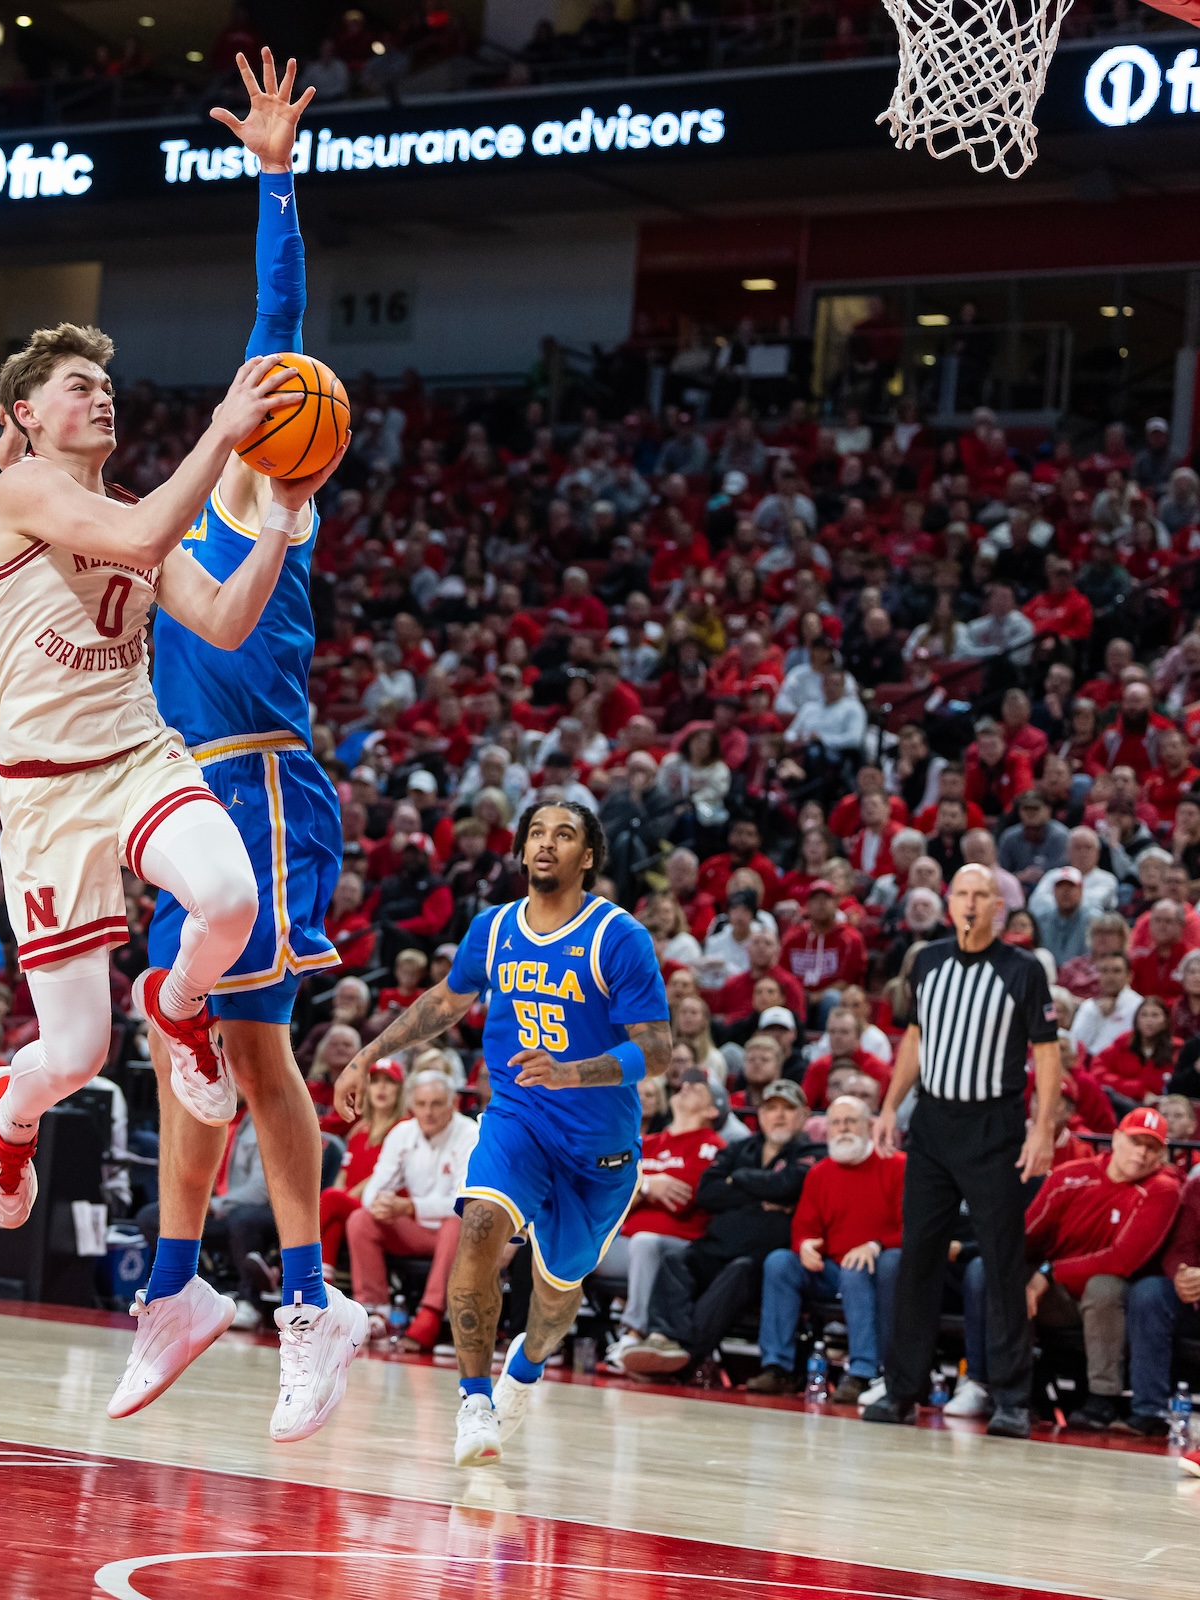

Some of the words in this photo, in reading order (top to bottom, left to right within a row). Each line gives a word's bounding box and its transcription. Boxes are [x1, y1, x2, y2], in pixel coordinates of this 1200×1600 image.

[159, 129, 313, 183] Trustd
[316, 127, 526, 172] insurance
[531, 103, 726, 156] advisors
[7, 142, 94, 199] fnic
[340, 290, 408, 326] 116
[95, 574, 133, 638] 0
[23, 885, 60, 935] N
[498, 960, 585, 1003] UCLA
[512, 999, 569, 1053] 55
